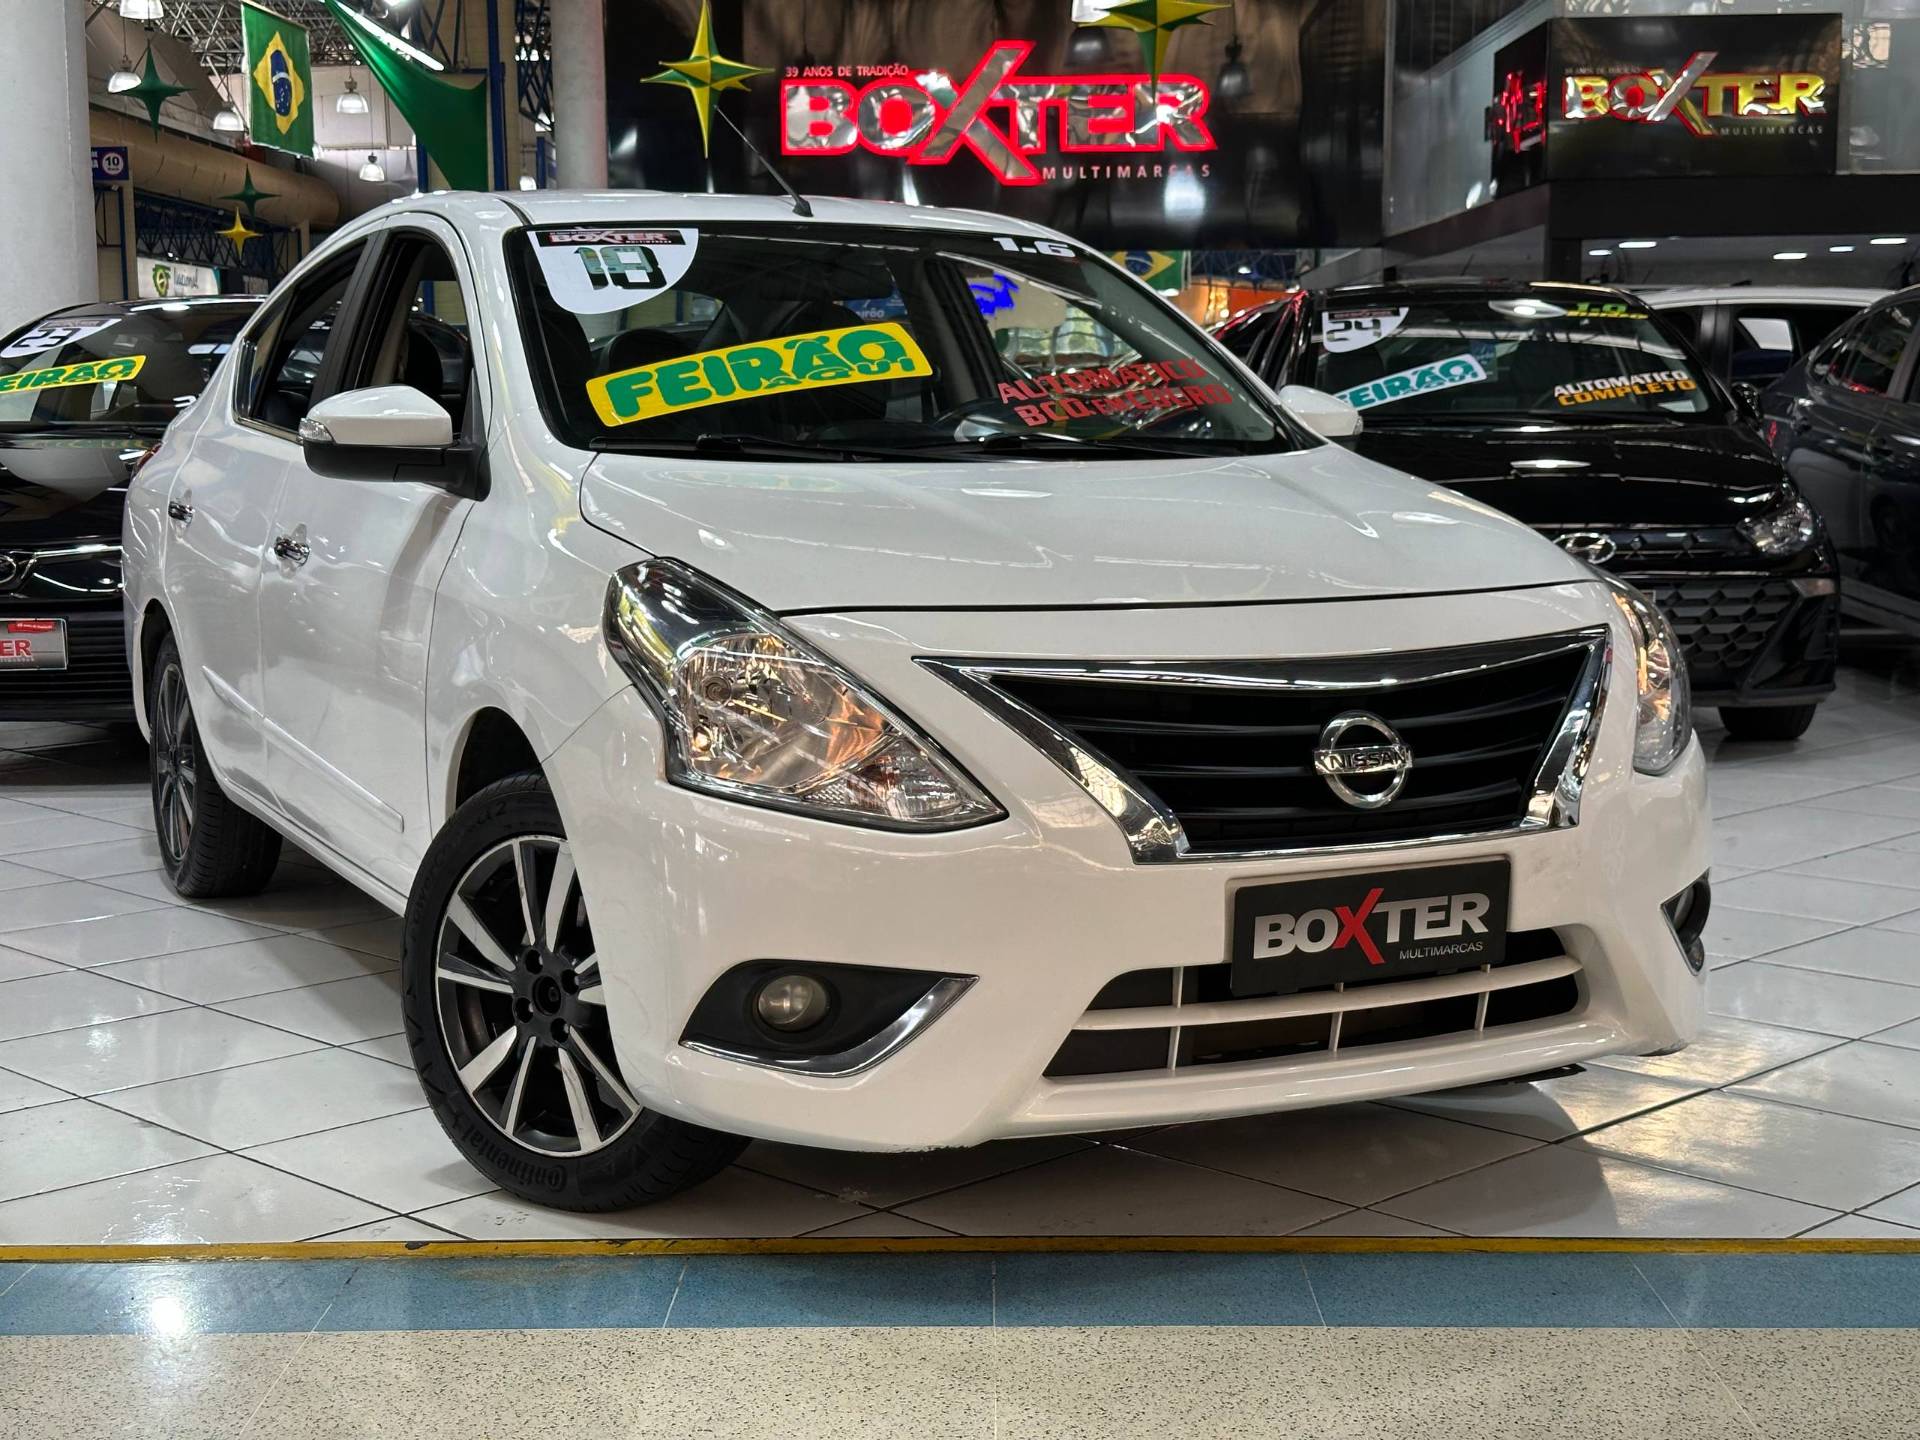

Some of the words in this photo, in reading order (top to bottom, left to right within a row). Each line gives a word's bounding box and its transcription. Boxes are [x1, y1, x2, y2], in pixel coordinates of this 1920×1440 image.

[785, 66, 799, 77] 39
[803, 66, 833, 77] ANOS
[838, 66, 852, 77] DE
[856, 64, 909, 78] TRADIÇÃO
[1563, 51, 1827, 137] BOXTER
[780, 40, 1217, 186] BOXTER
[1720, 125, 1824, 136] MULTIMARCAS
[105, 155, 120, 166] 10
[1043, 164, 1211, 179] MULTIMARCAS
[993, 237, 1076, 258] 1.6
[574, 245, 667, 290] 18
[12, 327, 81, 348] 23
[1326, 318, 1382, 342] 24
[605, 329, 907, 417] FEIRÃO
[764, 357, 916, 389] AQUI
[1557, 380, 1697, 407] COMPLETO
[1329, 750, 1407, 769] NISSAN
[1253, 887, 1490, 966] BOXTER
[1399, 941, 1484, 960] MULTIMARCAS
[462, 1123, 568, 1193] Continental
